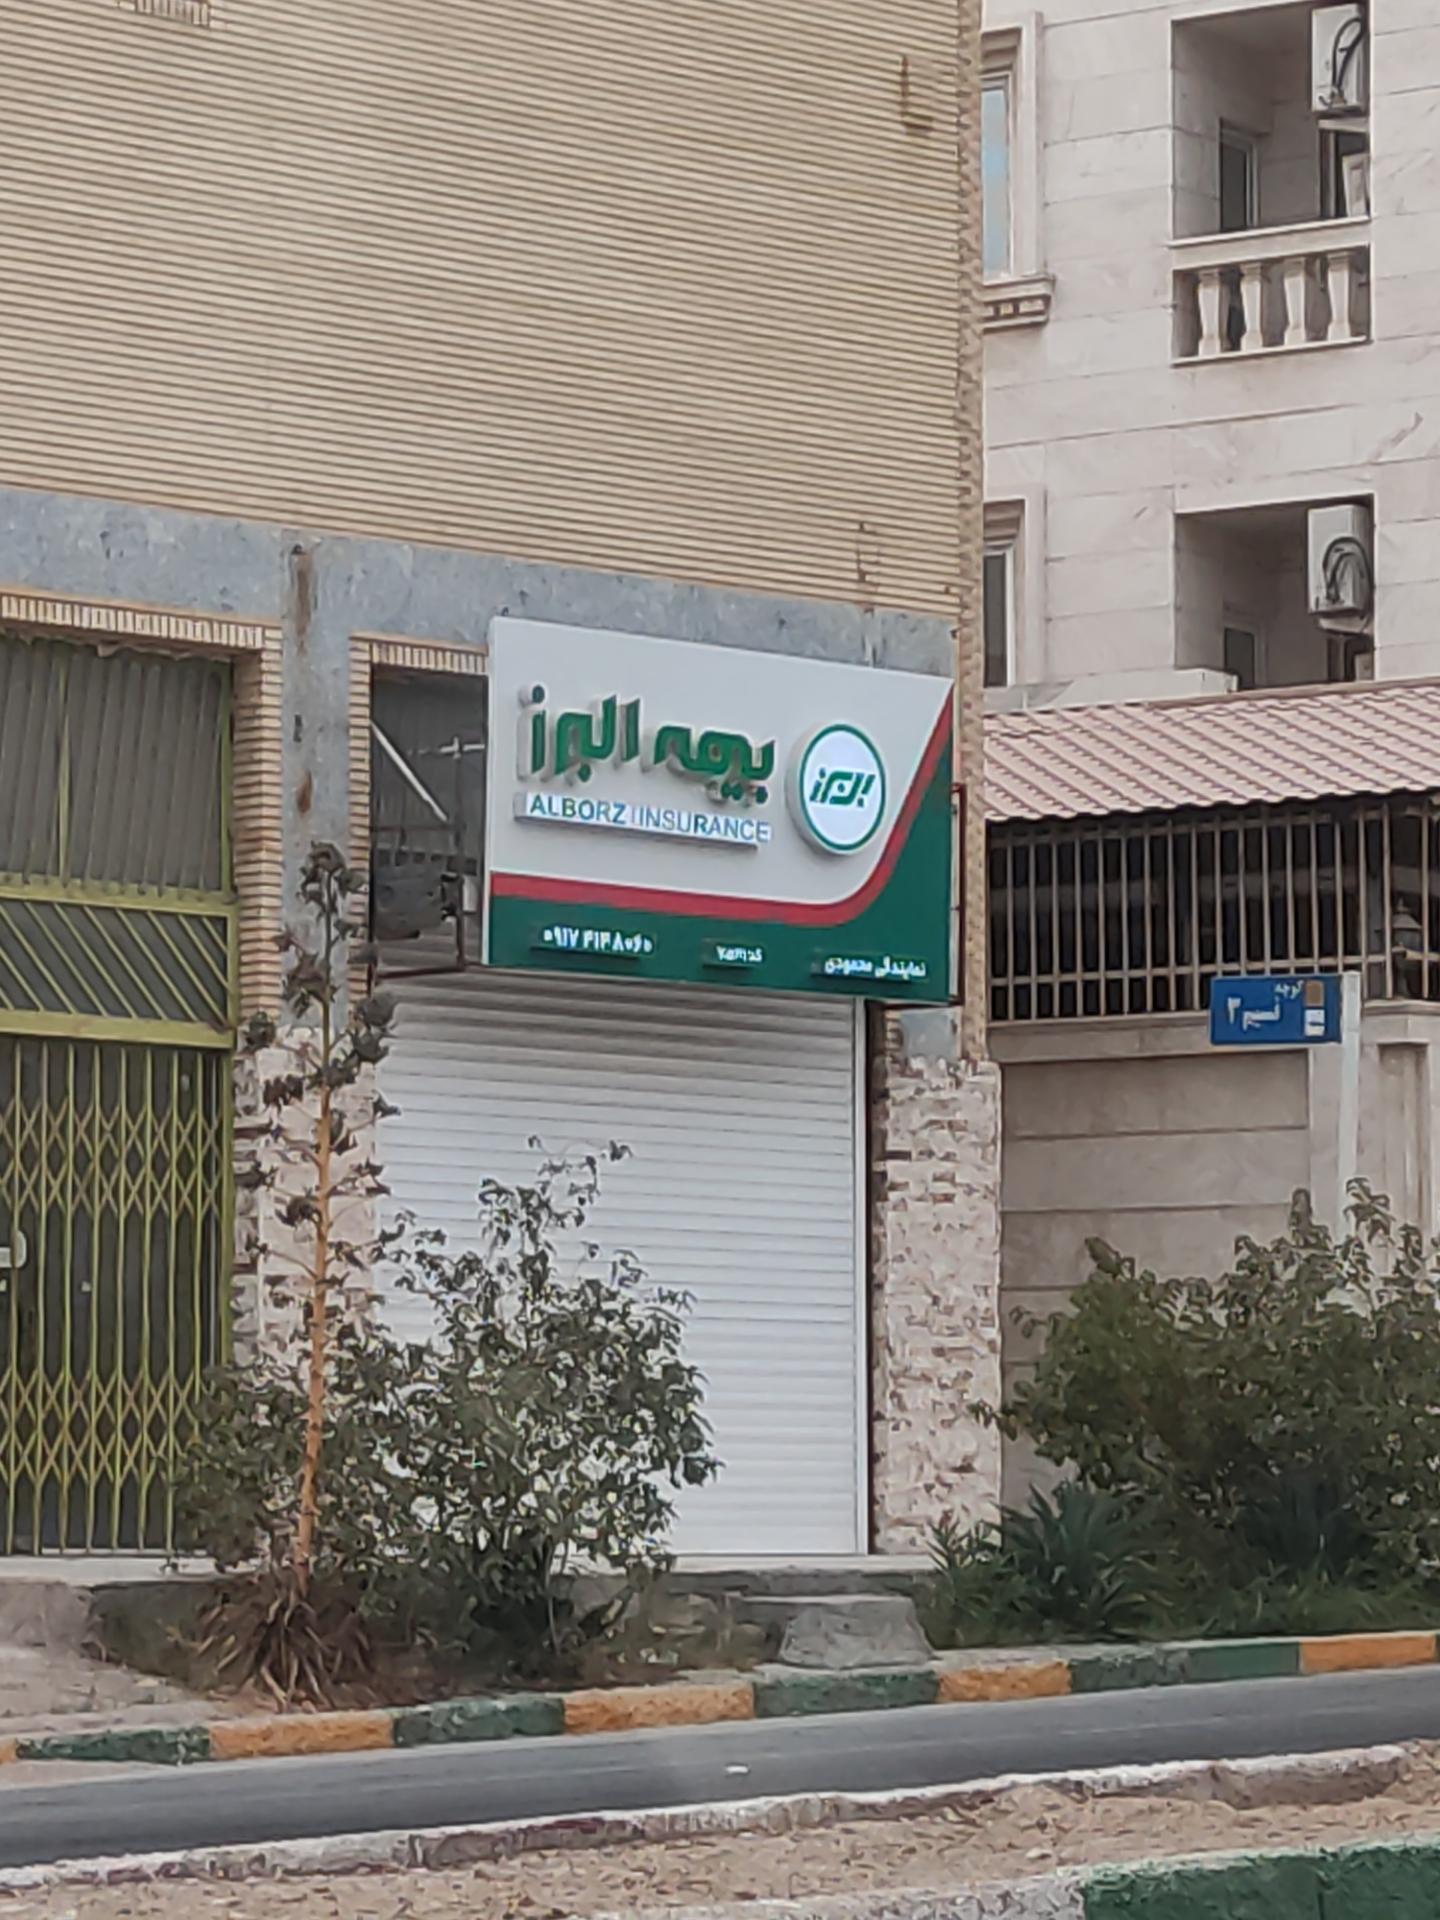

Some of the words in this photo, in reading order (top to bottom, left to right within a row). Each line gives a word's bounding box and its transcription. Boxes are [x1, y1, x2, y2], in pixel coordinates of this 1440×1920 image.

[531, 683, 641, 783] البرز
[653, 724, 776, 805] بیمه
[529, 793, 627, 826] ALBORZ
[638, 804, 770, 843] INSURANCE
